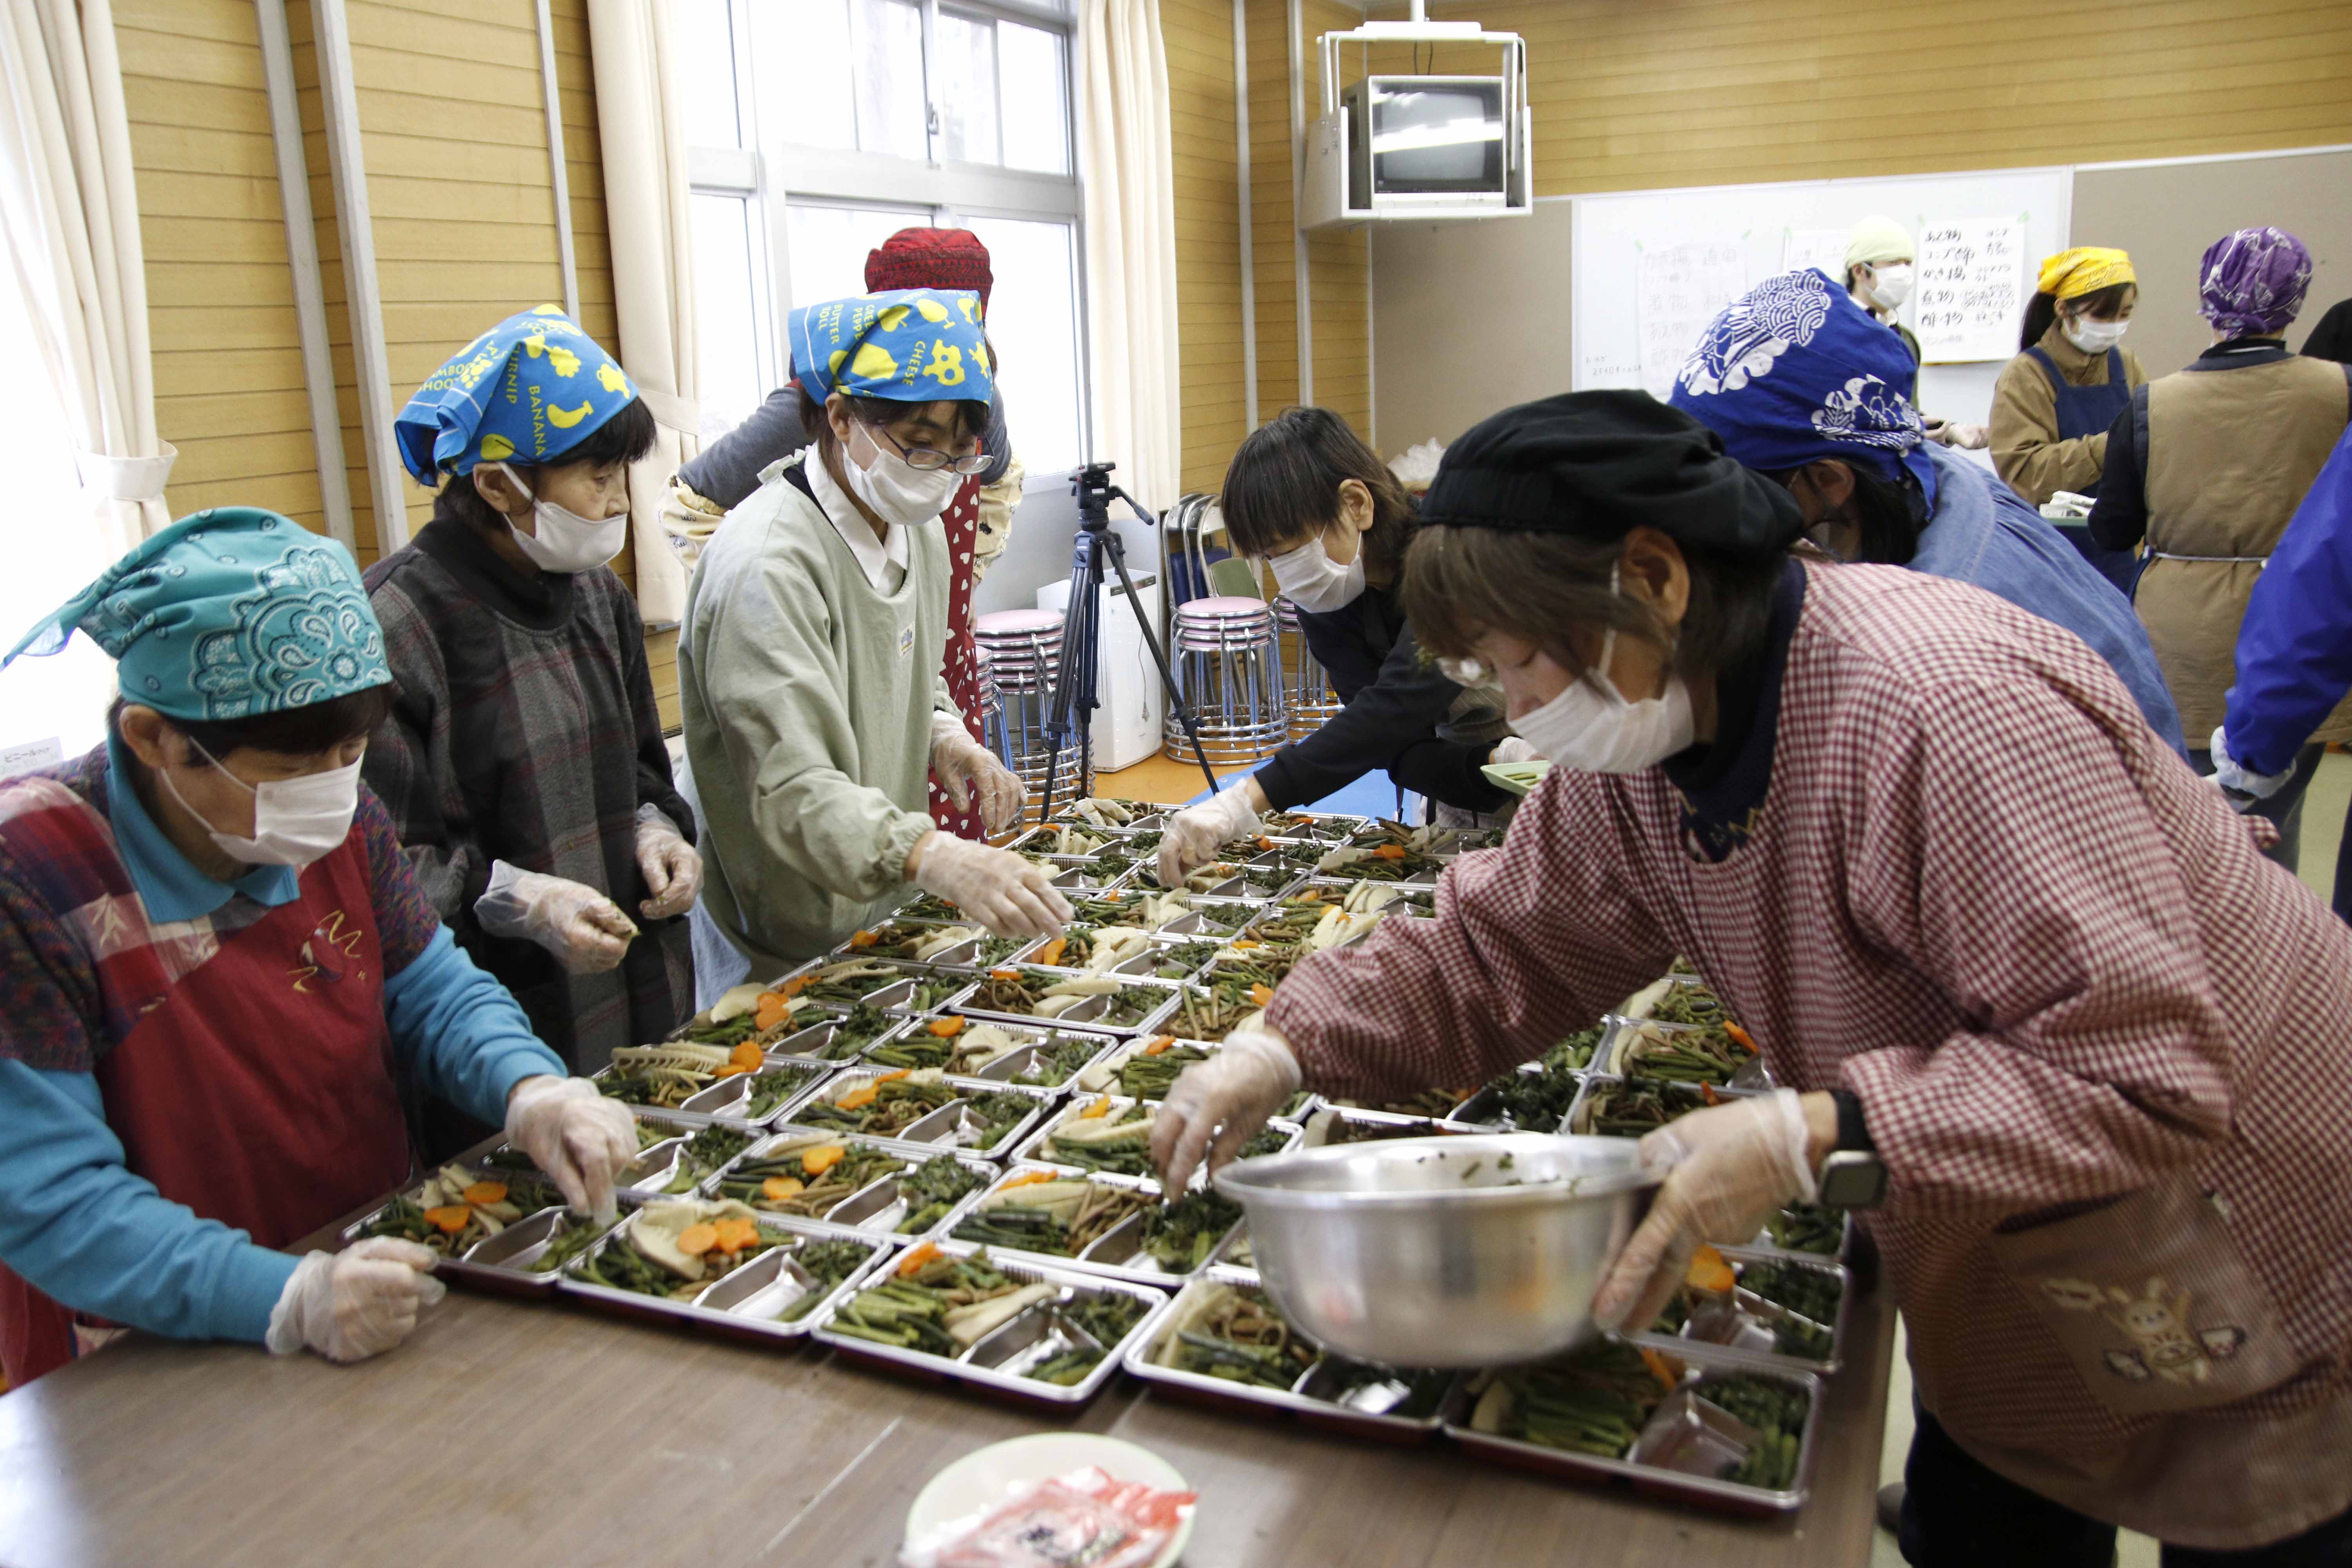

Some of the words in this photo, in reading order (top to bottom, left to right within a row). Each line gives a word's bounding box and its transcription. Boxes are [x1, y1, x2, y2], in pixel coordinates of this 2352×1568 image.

[818, 307, 831, 331] ROLL
[829, 304, 844, 345] BUTTER
[903, 340, 926, 386] CHEESE
[529, 385, 546, 456] BANANA
